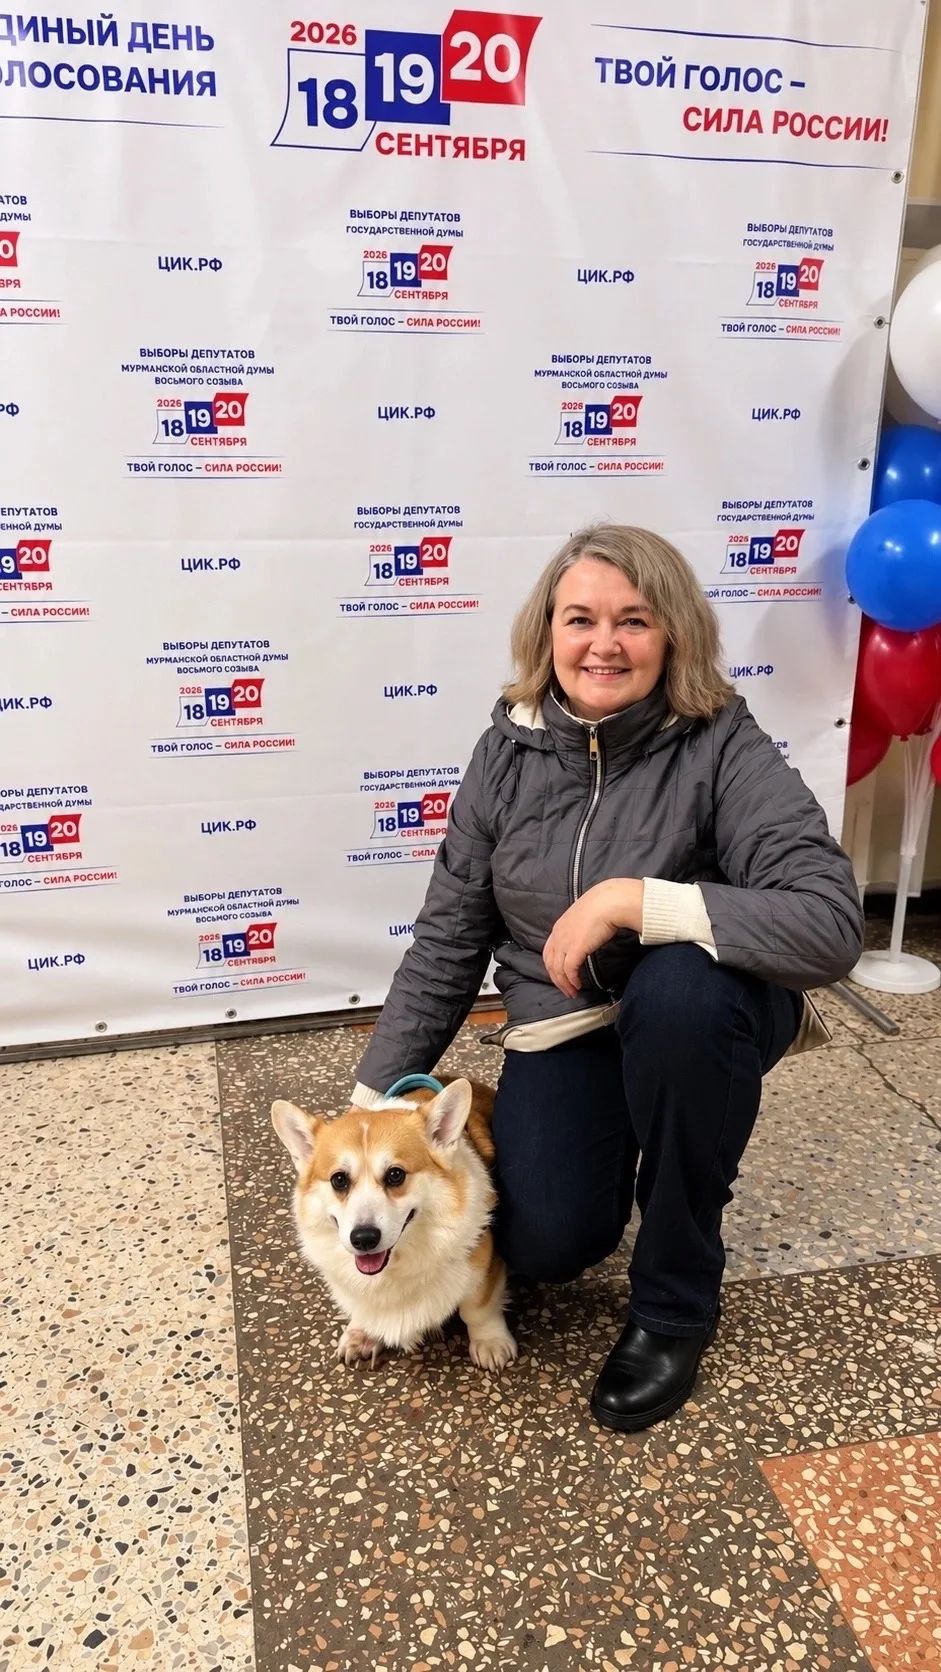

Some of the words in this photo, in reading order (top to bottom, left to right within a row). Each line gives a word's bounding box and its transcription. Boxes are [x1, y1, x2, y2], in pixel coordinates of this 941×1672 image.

[128, 21, 214, 51] ДЕНЬ
[290, 21, 357, 45] 2026
[0, 60, 217, 96] ЛОСОВАНИЯ
[298, 78, 358, 129] 18
[374, 52, 434, 104] 19
[449, 31, 521, 83] 20
[595, 56, 675, 88] ТВОЙ
[684, 65, 782, 93] ГОЛОС
[683, 107, 763, 133] СИЛА
[772, 111, 888, 142] РОССИИ!
[375, 133, 525, 161] СЕНТЯБРЯ
[1, 213, 31, 222] ДУМЫ
[350, 210, 397, 219] ВЫБОРЫ
[400, 211, 460, 222] ДЕПУТАТОВ
[346, 226, 434, 235] ГОСУДАРСТВЕННОЙ
[436, 229, 463, 237] ДУМЫ
[748, 223, 787, 232] ВЫБОРЫ
[788, 226, 833, 237] ДЕПУТАТОВ
[158, 256, 222, 272] ЦИК.РФ
[367, 271, 388, 289] 18
[394, 261, 416, 280] 19
[421, 253, 446, 271] 20
[577, 268, 634, 284] ЦИК.РФ
[757, 282, 774, 298] 18
[780, 272, 796, 290] 19
[800, 265, 818, 282] 20
[395, 290, 448, 300] СЕНТЯБРЯ
[11, 308, 60, 317] РОССИИ!
[331, 315, 358, 325] ТВОЙ
[361, 317, 395, 325] ГОЛОС
[407, 318, 433, 327] СИЛА
[437, 319, 480, 327] РОССИИ!
[721, 323, 745, 332] ТВОЙ
[748, 324, 776, 332] ГОЛОС
[786, 325, 807, 333] СИЛА
[140, 349, 188, 358] ВЫБОРЫ
[191, 350, 255, 359] ДЕПУТАТОВ
[552, 355, 594, 363] ВЫБОРЫ
[596, 356, 651, 365] ДЕПУТАТОВ
[122, 364, 187, 373] МУРМАНСКОЙ
[190, 365, 244, 373] ОБЛАСТНОЙ
[246, 367, 274, 375] ДУМЫ
[535, 369, 591, 377] МУРМАНСКОЙ
[594, 370, 641, 378] ОБЛАСТНОЙ
[155, 377, 204, 385] ВОСЬМОГО
[161, 419, 184, 436] 18
[188, 409, 210, 427] 19
[215, 401, 242, 418] 20
[377, 406, 435, 421] ЦИК.РФ
[752, 408, 801, 421] ЦИК.РФ
[564, 421, 582, 437] 18
[588, 411, 607, 429] 19
[612, 403, 636, 420] 20
[191, 438, 247, 446] СЕНТЯБРЯ
[587, 438, 636, 446] СЕНТЯБРЯ
[127, 462, 155, 472] ТВОЙ
[159, 464, 193, 472] ГОЛОС
[205, 464, 233, 472] СИЛА
[236, 464, 282, 472] РОССИИ!
[529, 461, 553, 471] ТВОЙ
[625, 462, 663, 470] РОССИИ!
[357, 507, 400, 515] ВЫБОРЫ
[403, 506, 460, 515] ДЕПУТАТОВ
[722, 501, 761, 509] ВЫБОРЫ
[764, 500, 813, 509] ДЕПУТАТОВ
[717, 513, 791, 522] ГОСУДАРСТВЕННОЙ
[34, 523, 62, 531] ДУМЫ
[354, 519, 435, 529] ГОСУДАРСТВЕННОЙ
[437, 520, 463, 528] ДУМЫ
[19, 547, 46, 564] 20
[729, 552, 746, 567] 18
[753, 543, 771, 559] 19
[775, 536, 798, 551] 20
[181, 558, 241, 573] ЦИК.РФ
[373, 563, 392, 579] 18
[397, 553, 417, 570] 19
[422, 544, 446, 560] 20
[399, 578, 448, 586] СЕНТЯБРЯ
[758, 588, 780, 596] СИЛА
[11, 608, 40, 616] СИЛА
[43, 608, 89, 616] РОССИИ!
[340, 602, 365, 612] ТВОЙ
[368, 603, 399, 611] ГОЛОС
[410, 602, 435, 610] СИЛА
[438, 601, 478, 609] РОССИИ!
[163, 642, 208, 650] ВЫБОРЫ
[211, 640, 269, 650] ДЕПУТАТОВ
[147, 655, 208, 664] МУРМАНСКОЙ
[210, 653, 260, 662] ОБЛАСТНОЙ
[262, 654, 288, 662] ДУМЫ
[177, 666, 222, 674] ВОСЬМОГО
[729, 665, 774, 678] ЦИК.РФ
[384, 684, 438, 699] ЦИК.РФ
[184, 704, 204, 720] 18
[209, 694, 229, 710] 19
[233, 685, 258, 702] 20
[211, 718, 262, 727] СЕНТЯБРЯ
[151, 743, 178, 752] ТВОЙ
[181, 743, 213, 751] ГОЛОС
[225, 741, 250, 749] СИЛА
[253, 739, 295, 748] РОССИИ!
[364, 771, 404, 779] ВЫБОРЫ
[406, 767, 459, 778] ДЕПУТАТОВ
[360, 779, 436, 791] ГОСУДАРСТВЕННОЙ
[27, 786, 88, 797] ДЕПУТАТОВ
[65, 799, 92, 807] ДУМЫ
[378, 817, 396, 832] 18
[400, 808, 419, 823] 19
[423, 800, 444, 814] 20
[201, 819, 257, 835] ЦИК.РФ
[1, 842, 21, 857] 18
[25, 831, 47, 847] 19
[51, 821, 76, 837] 20
[28, 852, 82, 863] СЕНТЯБРЯ
[347, 851, 370, 861] ТВОЙ
[373, 851, 401, 859] ГОЛОС
[412, 849, 435, 857] СИЛА
[44, 876, 71, 884] СИЛА
[74, 872, 117, 882] РОССИИ!
[184, 892, 225, 902] ВЫБОРЫ
[228, 888, 282, 899] ДЕПУТАТОВ
[203, 948, 222, 962] 18
[226, 939, 244, 953] 19
[248, 929, 271, 944] 20
[27, 953, 85, 971] ЦИК.РФ
[173, 983, 197, 993] ТВОЙ
[200, 981, 230, 990] ГОЛОС
[240, 977, 264, 986] СИЛА
